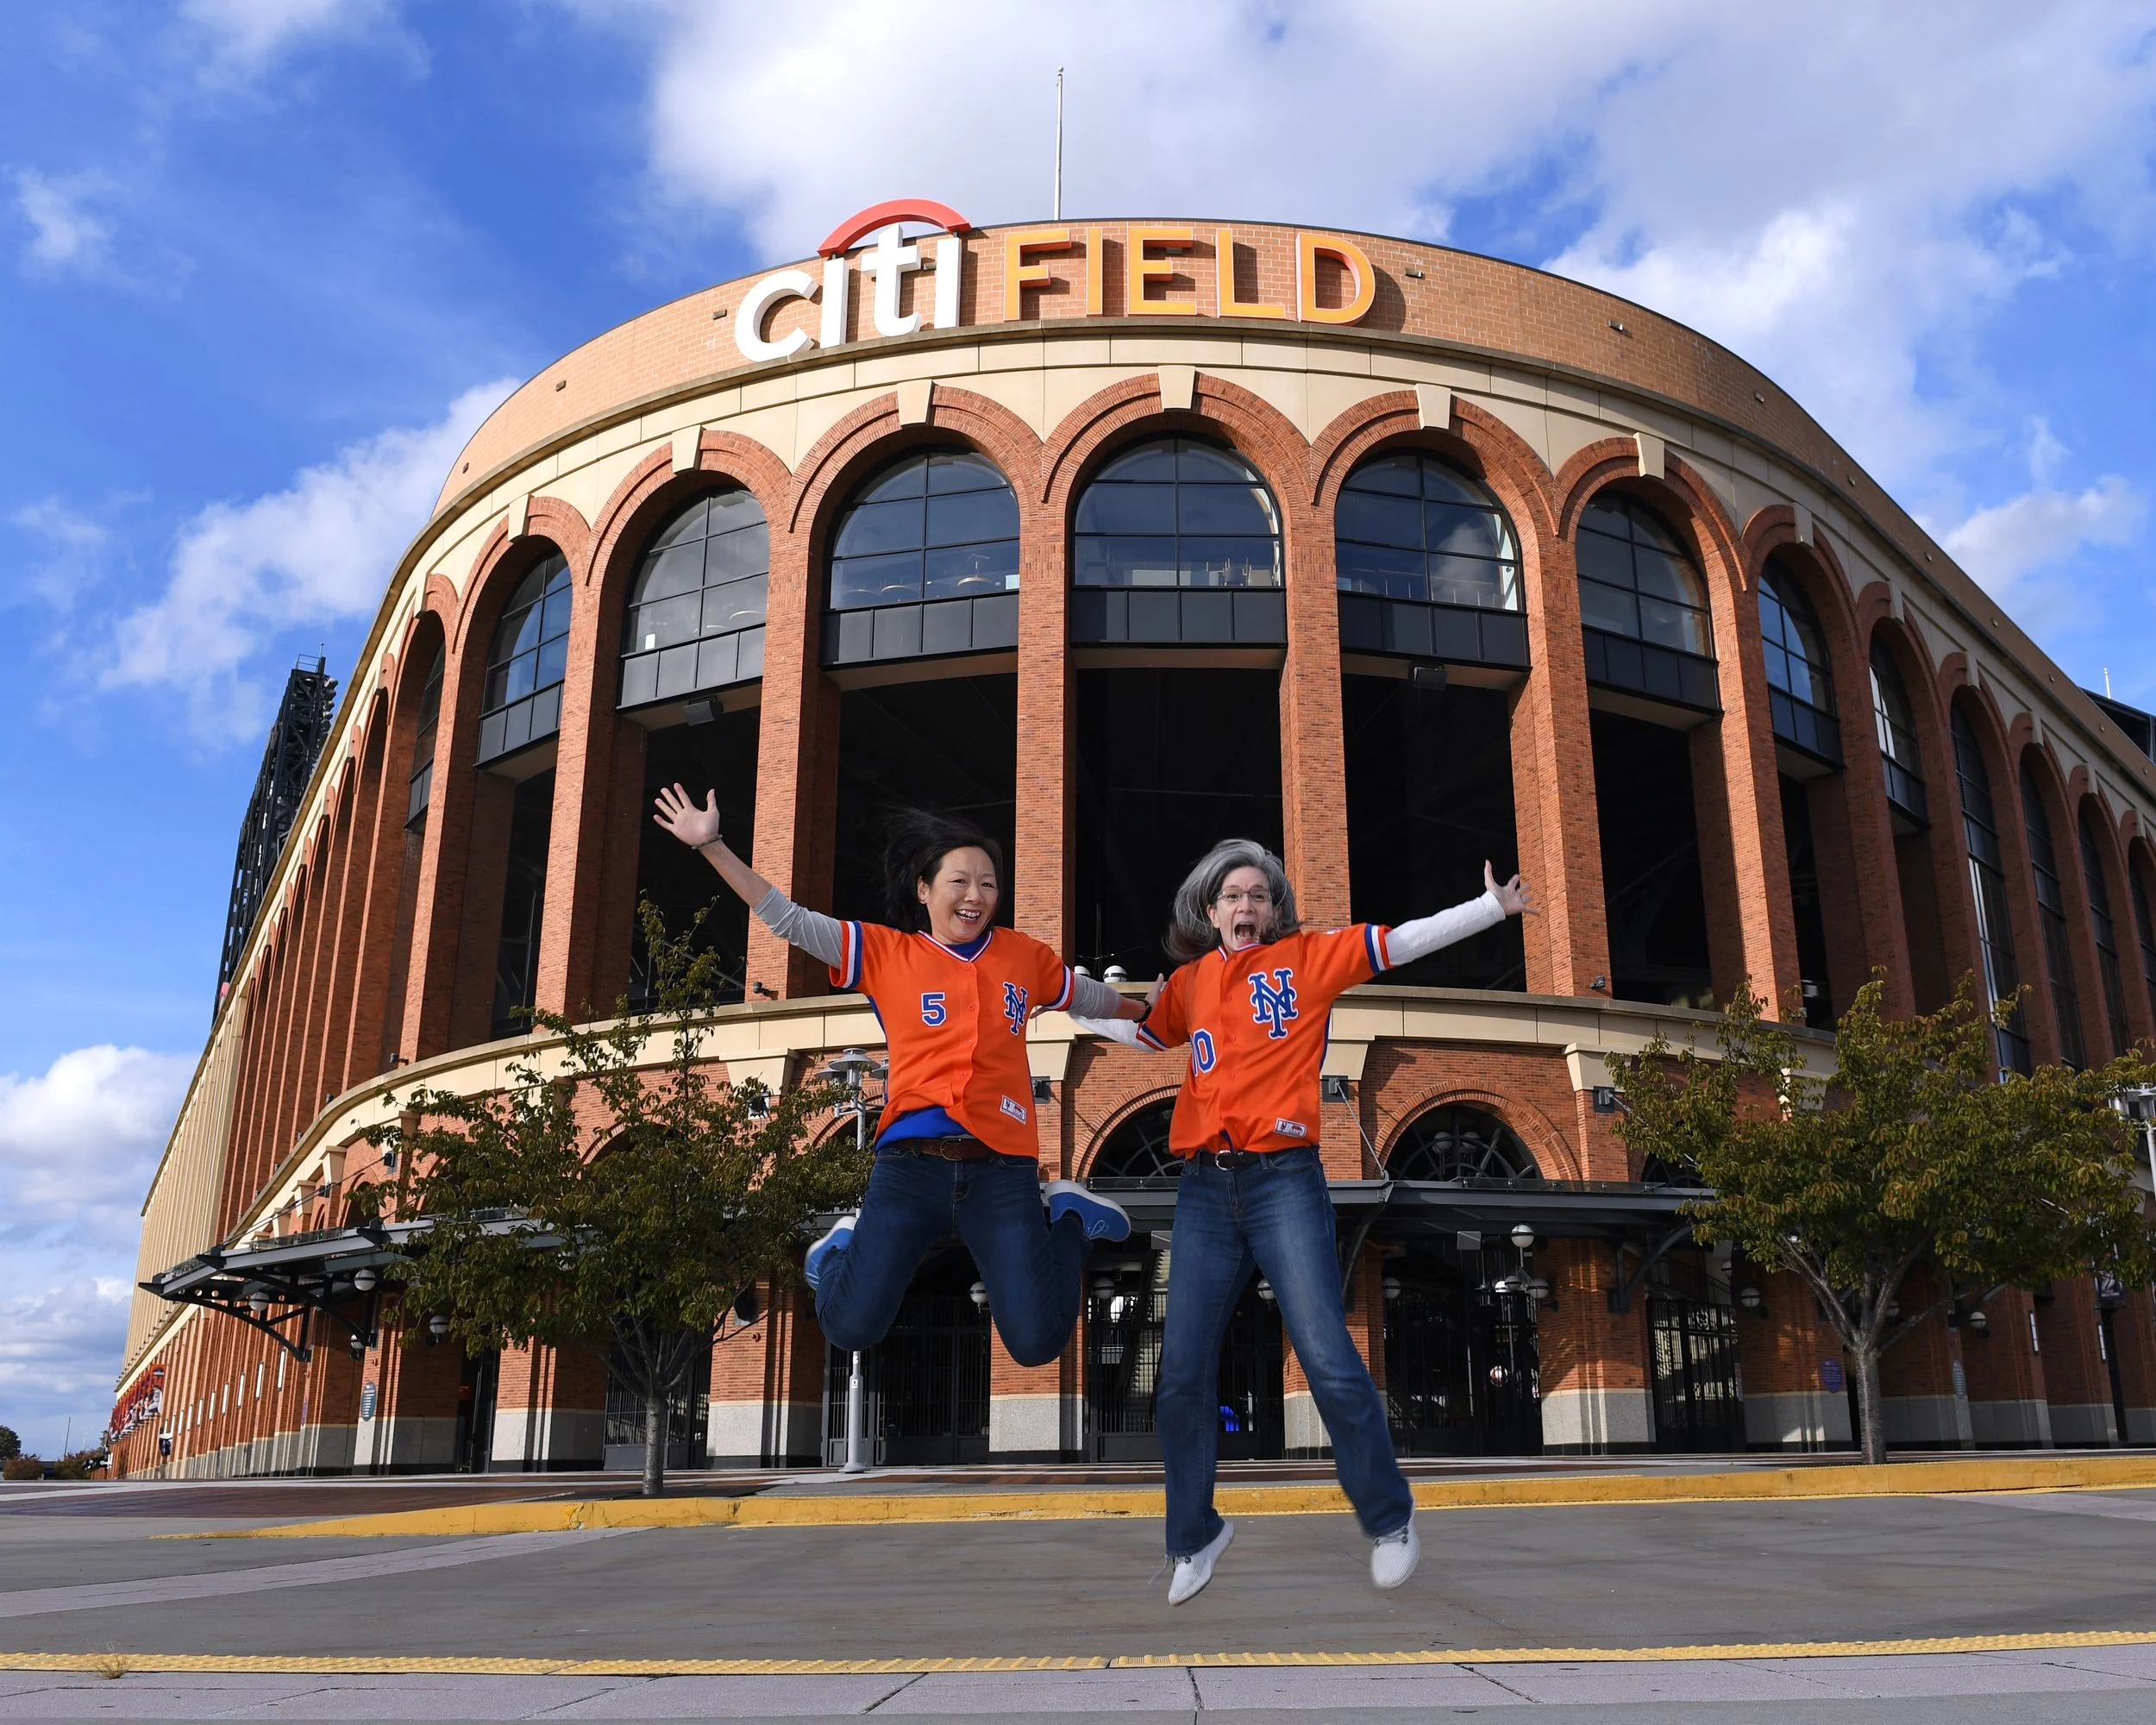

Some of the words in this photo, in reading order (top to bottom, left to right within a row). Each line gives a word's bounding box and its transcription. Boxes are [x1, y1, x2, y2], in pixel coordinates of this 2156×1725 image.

[734, 222, 962, 362] citi
[1003, 227, 1377, 325] FIELD
[920, 992, 947, 1027] 5
